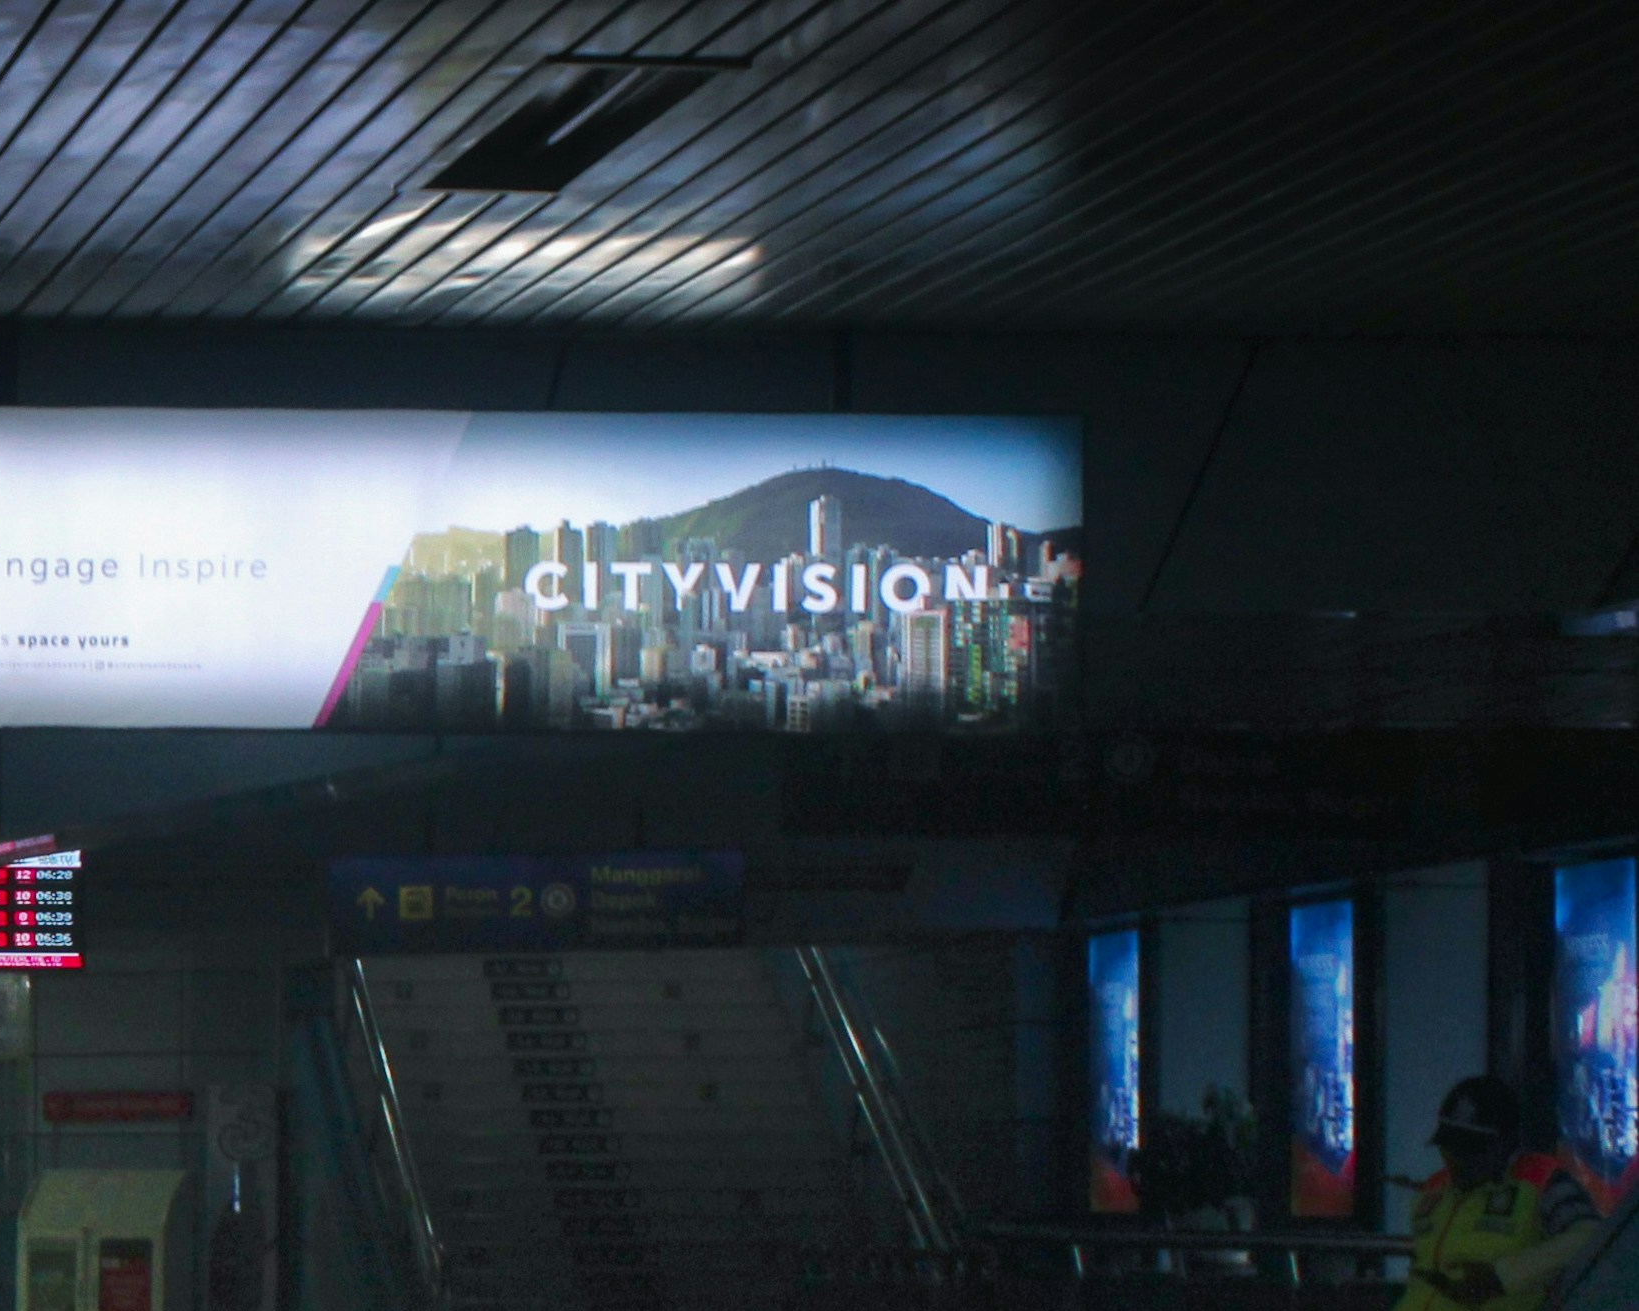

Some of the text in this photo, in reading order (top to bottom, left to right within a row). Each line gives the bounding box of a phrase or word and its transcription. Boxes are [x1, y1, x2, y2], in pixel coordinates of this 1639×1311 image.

[139, 552, 269, 584] Inspire
[525, 561, 990, 614] CITYVISION
[18, 634, 70, 650] space
[78, 634, 130, 650] yours
[16, 870, 31, 879] 12
[36, 870, 73, 880] 06:28
[510, 885, 532, 917] 2
